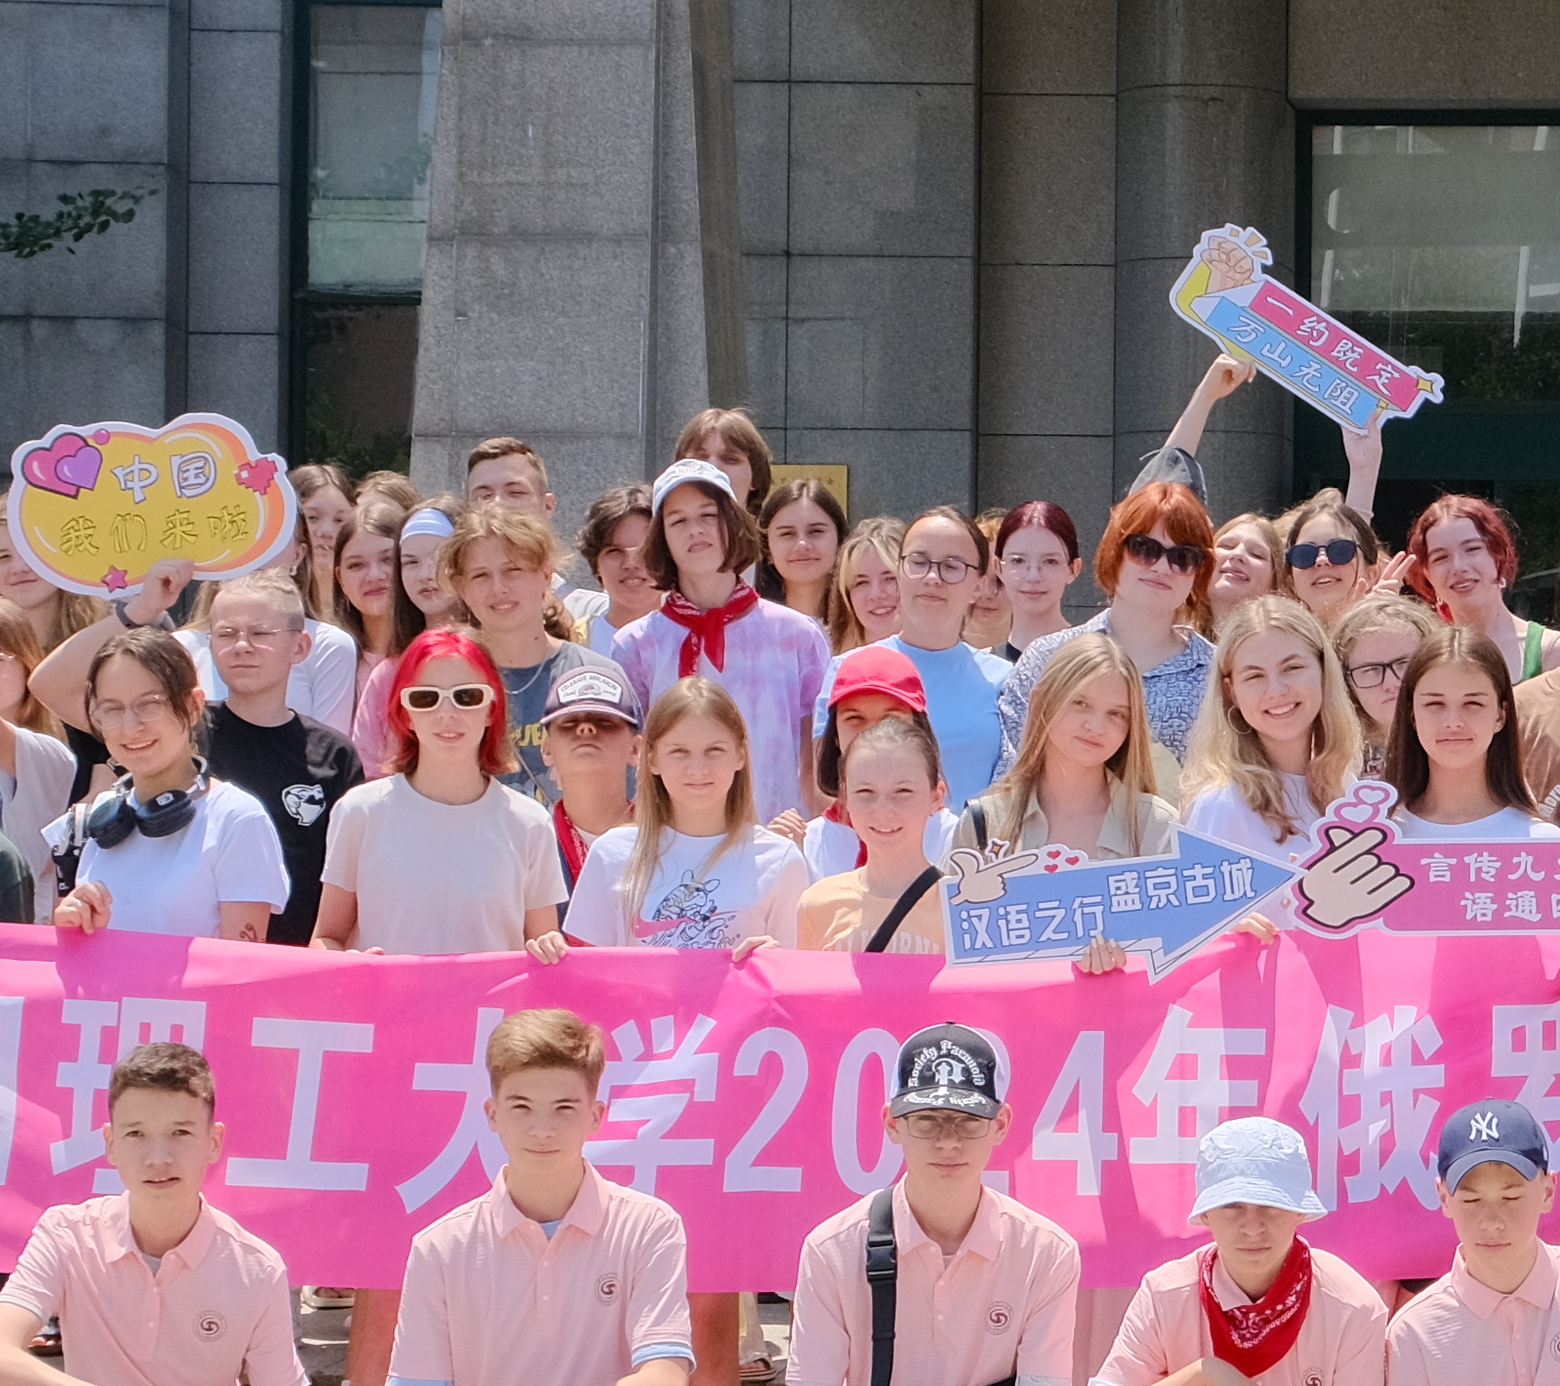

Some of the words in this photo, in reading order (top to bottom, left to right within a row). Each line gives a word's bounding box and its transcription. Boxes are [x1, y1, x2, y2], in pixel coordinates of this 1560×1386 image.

[1227, 314, 1361, 415] 万山无阻
[1266, 296, 1401, 397] 一约既定
[111, 451, 217, 504] 中国
[59, 504, 249, 556] 我们来啦
[1107, 856, 1257, 913] 盛京古城
[959, 894, 1105, 952] 汉语之行
[1468, 1111, 1500, 1142] NY
